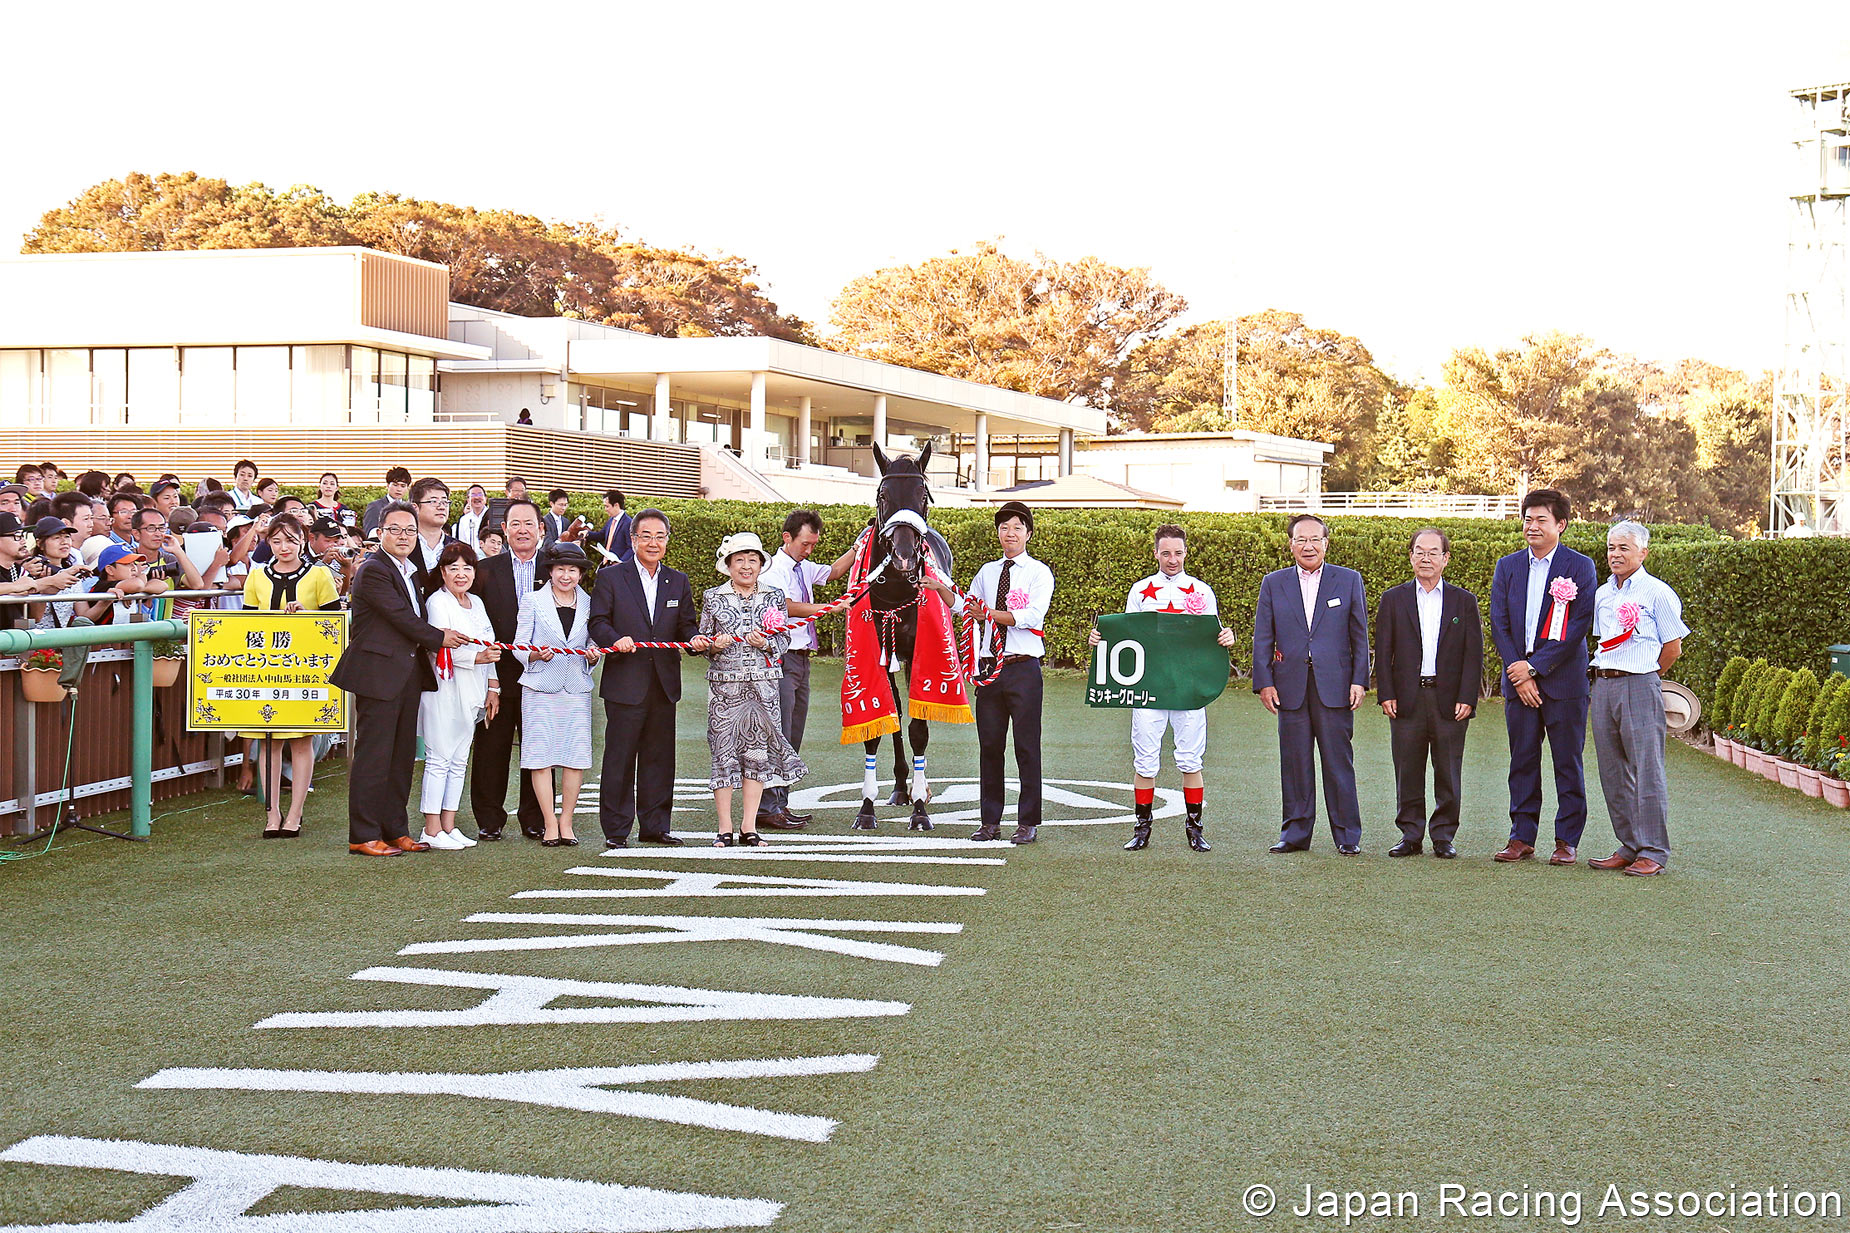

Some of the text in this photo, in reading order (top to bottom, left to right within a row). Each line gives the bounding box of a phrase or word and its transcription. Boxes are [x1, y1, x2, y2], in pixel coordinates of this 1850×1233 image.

[245, 630, 292, 649] 優勝
[202, 652, 335, 669] おめでとうございます
[1096, 639, 1145, 686] 10
[215, 674, 320, 684] 一般社団法人中山馬主協会
[922, 679, 965, 695] 201
[215, 688, 319, 700] 平成30年 9月 9日
[1088, 687, 1157, 707] ミッキーグローリー
[840, 696, 880, 714] 018
